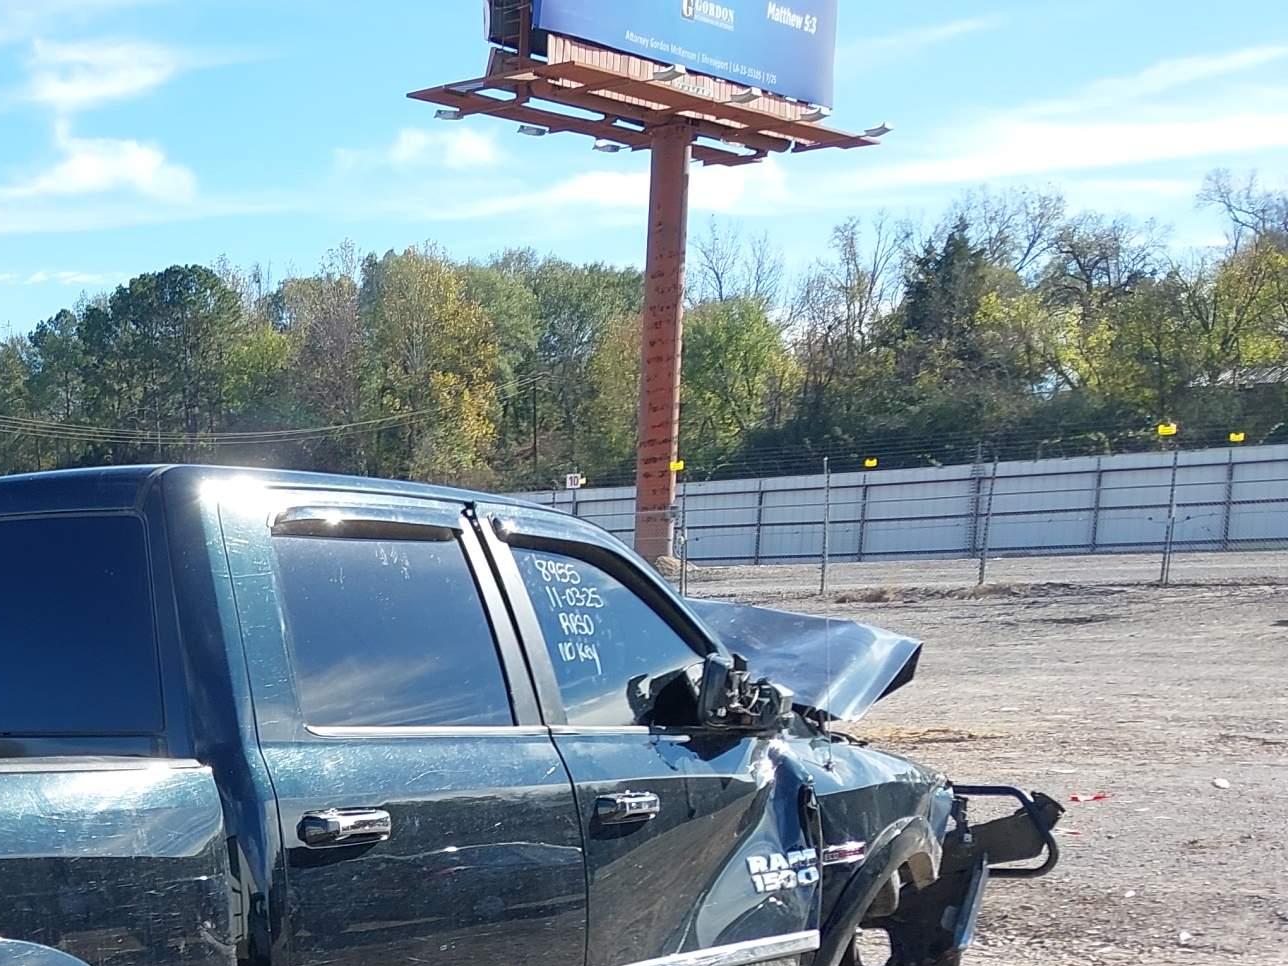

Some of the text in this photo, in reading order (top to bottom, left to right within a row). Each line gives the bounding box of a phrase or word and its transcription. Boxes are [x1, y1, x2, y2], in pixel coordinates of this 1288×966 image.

[695, 0, 735, 25] GORDON
[767, 2, 818, 35] Matthew 5:3
[625, 30, 649, 48] Attorney
[650, 37, 670, 53] Gordon
[568, 475, 579, 487] 10
[534, 557, 581, 584] 8955
[746, 848, 817, 875] RAM
[751, 866, 820, 893] 1500
